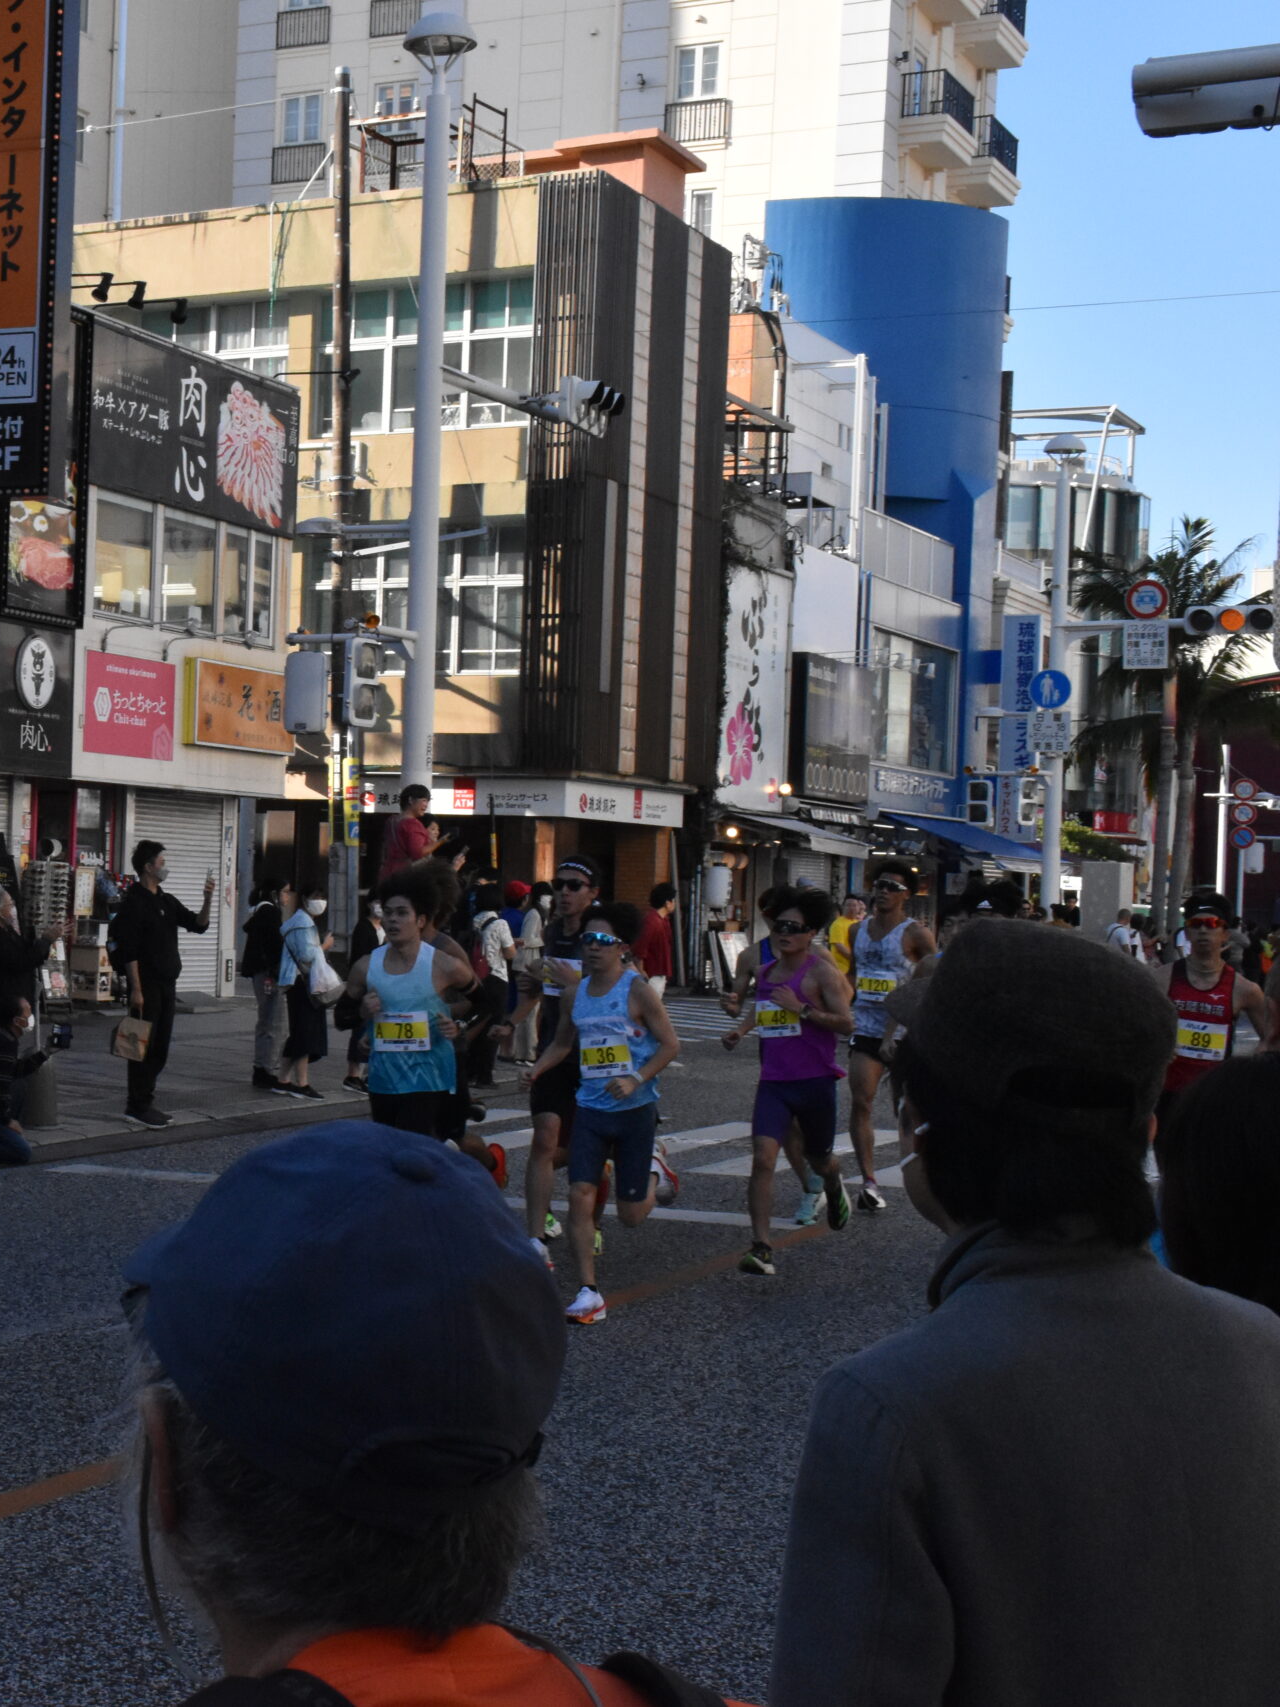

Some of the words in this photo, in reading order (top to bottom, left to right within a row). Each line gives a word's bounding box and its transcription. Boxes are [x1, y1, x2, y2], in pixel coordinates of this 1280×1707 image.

[174, 365, 208, 503] 肉心
[20, 719, 49, 752] 肉心
[454, 799, 474, 809] ATM
[868, 978, 889, 992] 120
[771, 1009, 787, 1025] 48
[375, 1023, 384, 1039] A
[394, 1022, 414, 1039] 78
[1190, 1031, 1211, 1048] 89
[596, 1046, 616, 1064] 36
